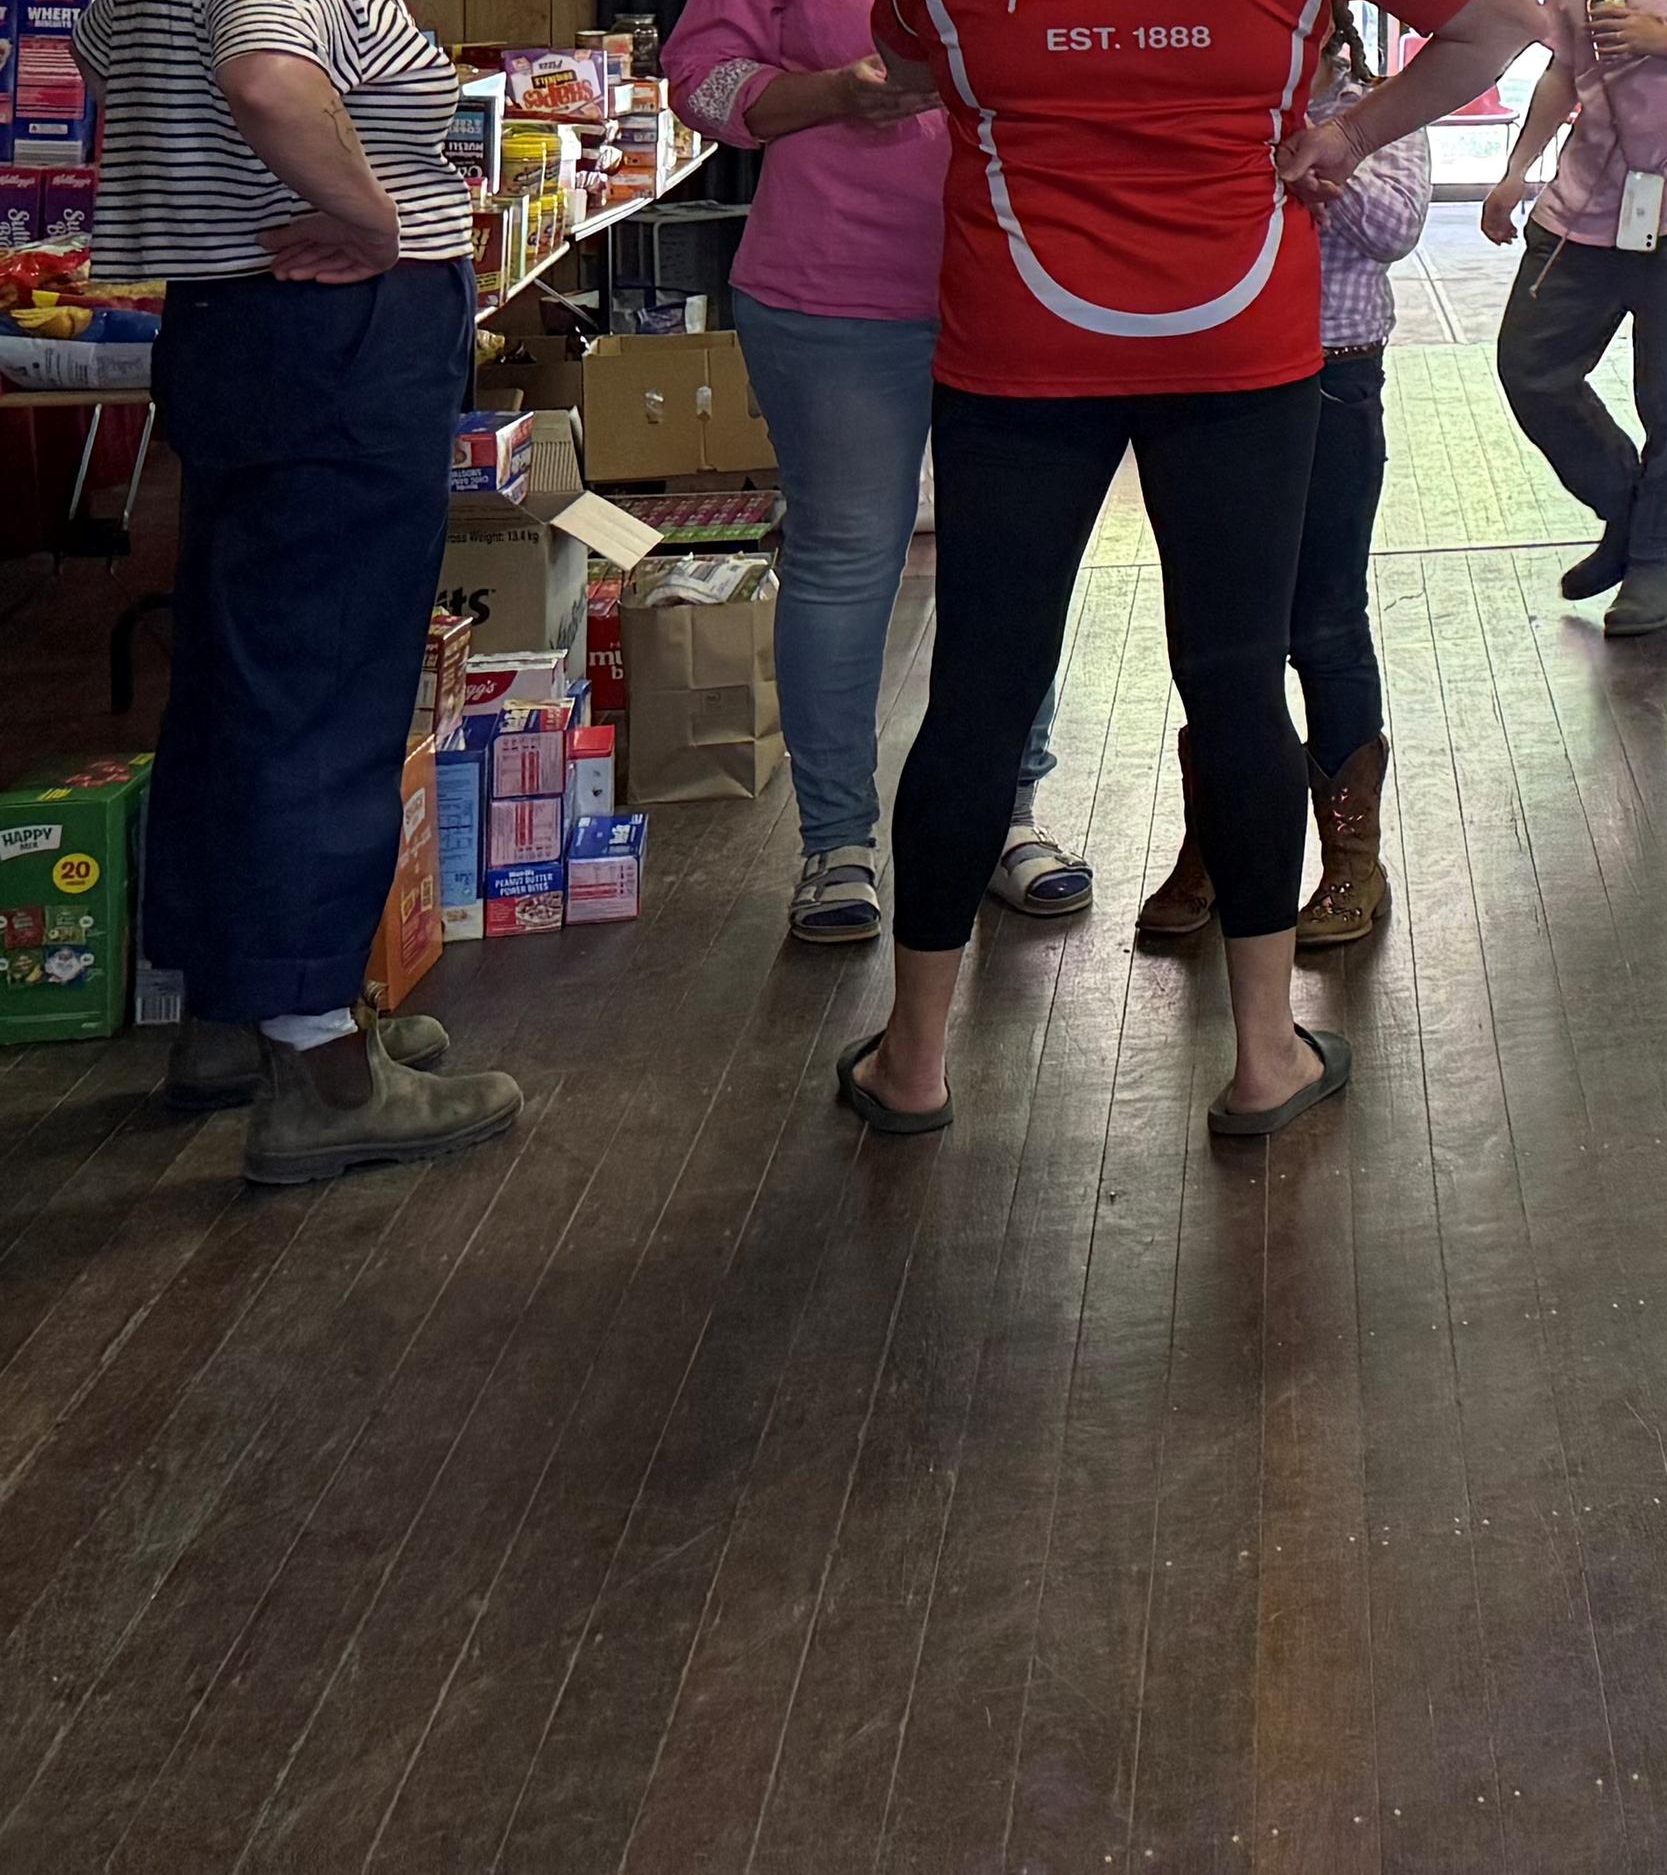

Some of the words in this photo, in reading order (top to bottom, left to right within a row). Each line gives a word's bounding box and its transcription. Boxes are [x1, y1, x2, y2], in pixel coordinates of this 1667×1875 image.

[1046, 28, 1120, 51] EST.
[1132, 26, 1212, 49] 1888
[469, 530, 504, 545] Weight:
[507, 530, 526, 542] 13.4
[528, 531, 540, 544] kg
[1, 827, 53, 847] HAPPY
[60, 860, 91, 880] 20
